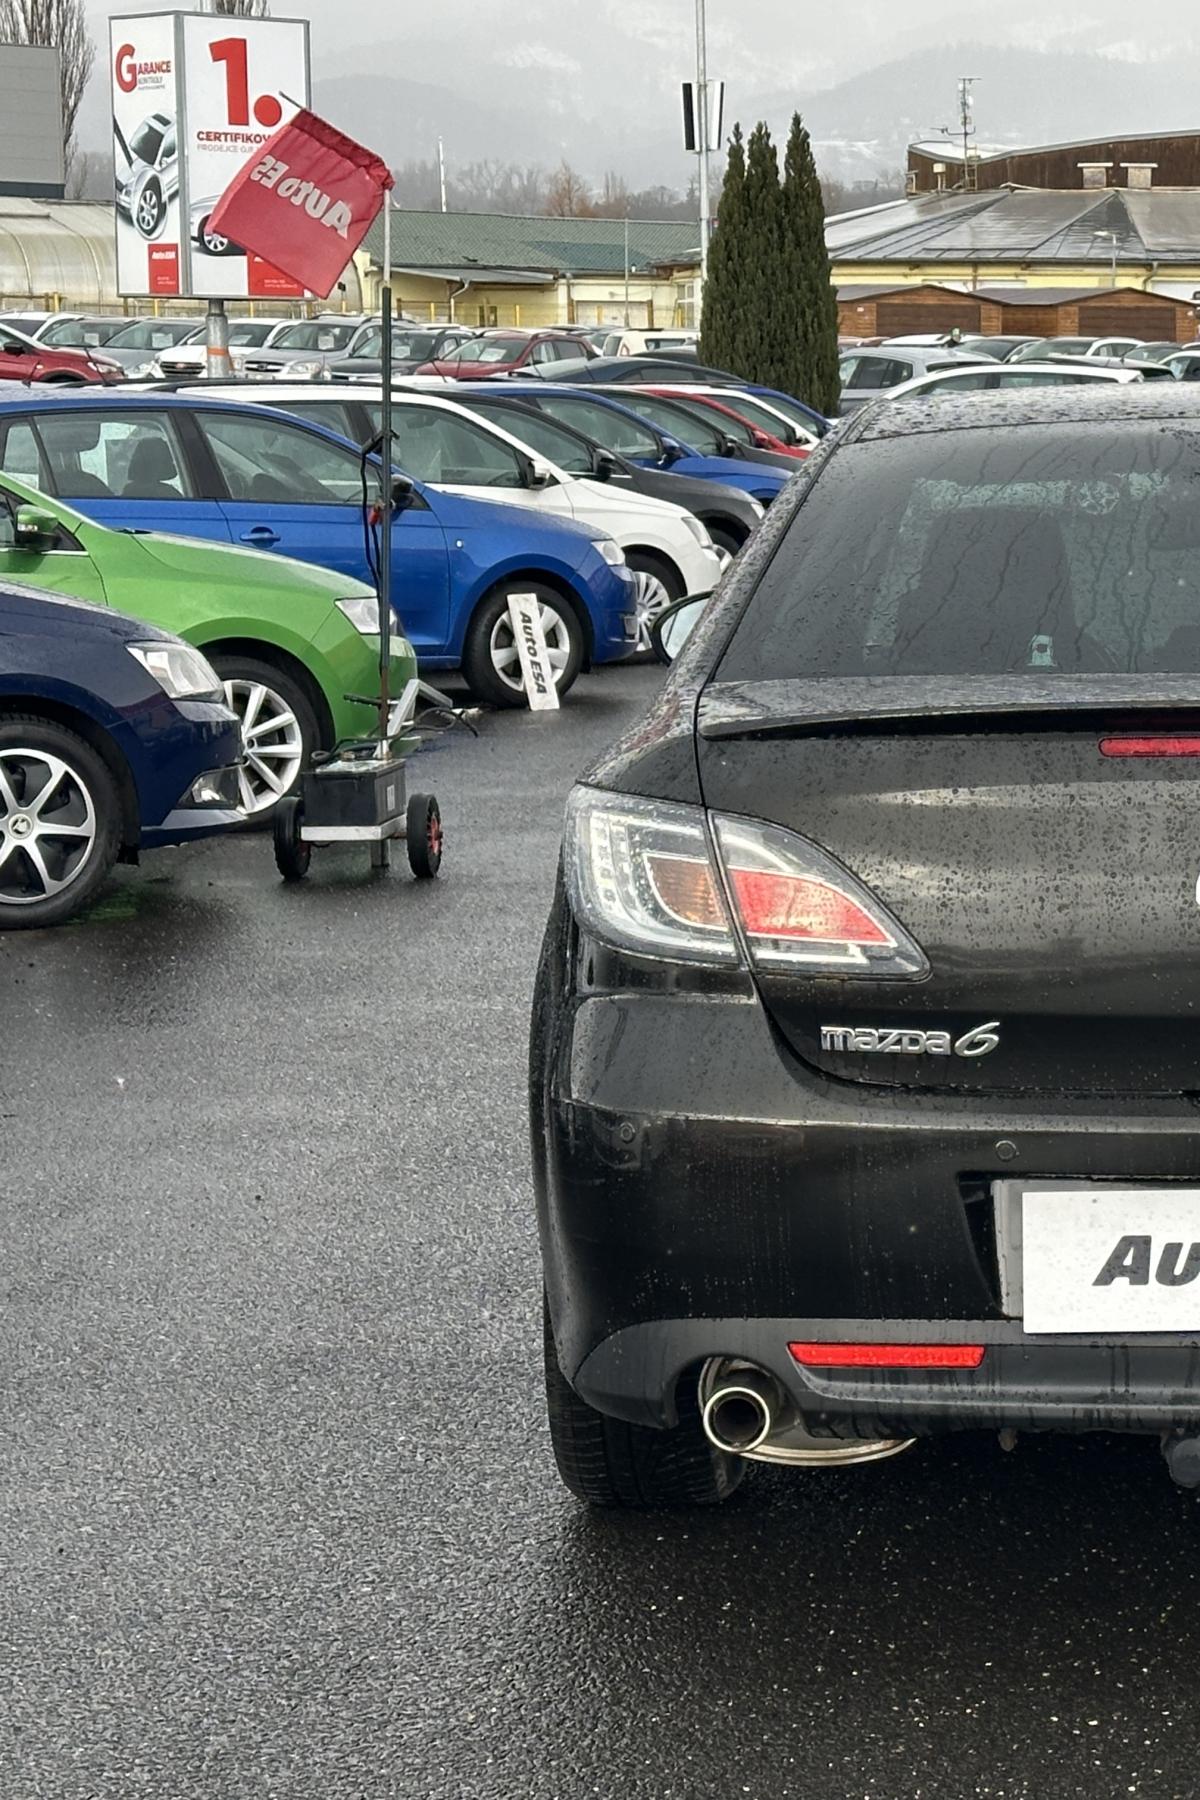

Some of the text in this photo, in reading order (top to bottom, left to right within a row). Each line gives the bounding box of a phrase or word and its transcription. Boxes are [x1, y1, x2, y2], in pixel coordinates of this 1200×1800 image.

[116, 43, 172, 92] GARANCE
[519, 610, 548, 694] Auto ESA
